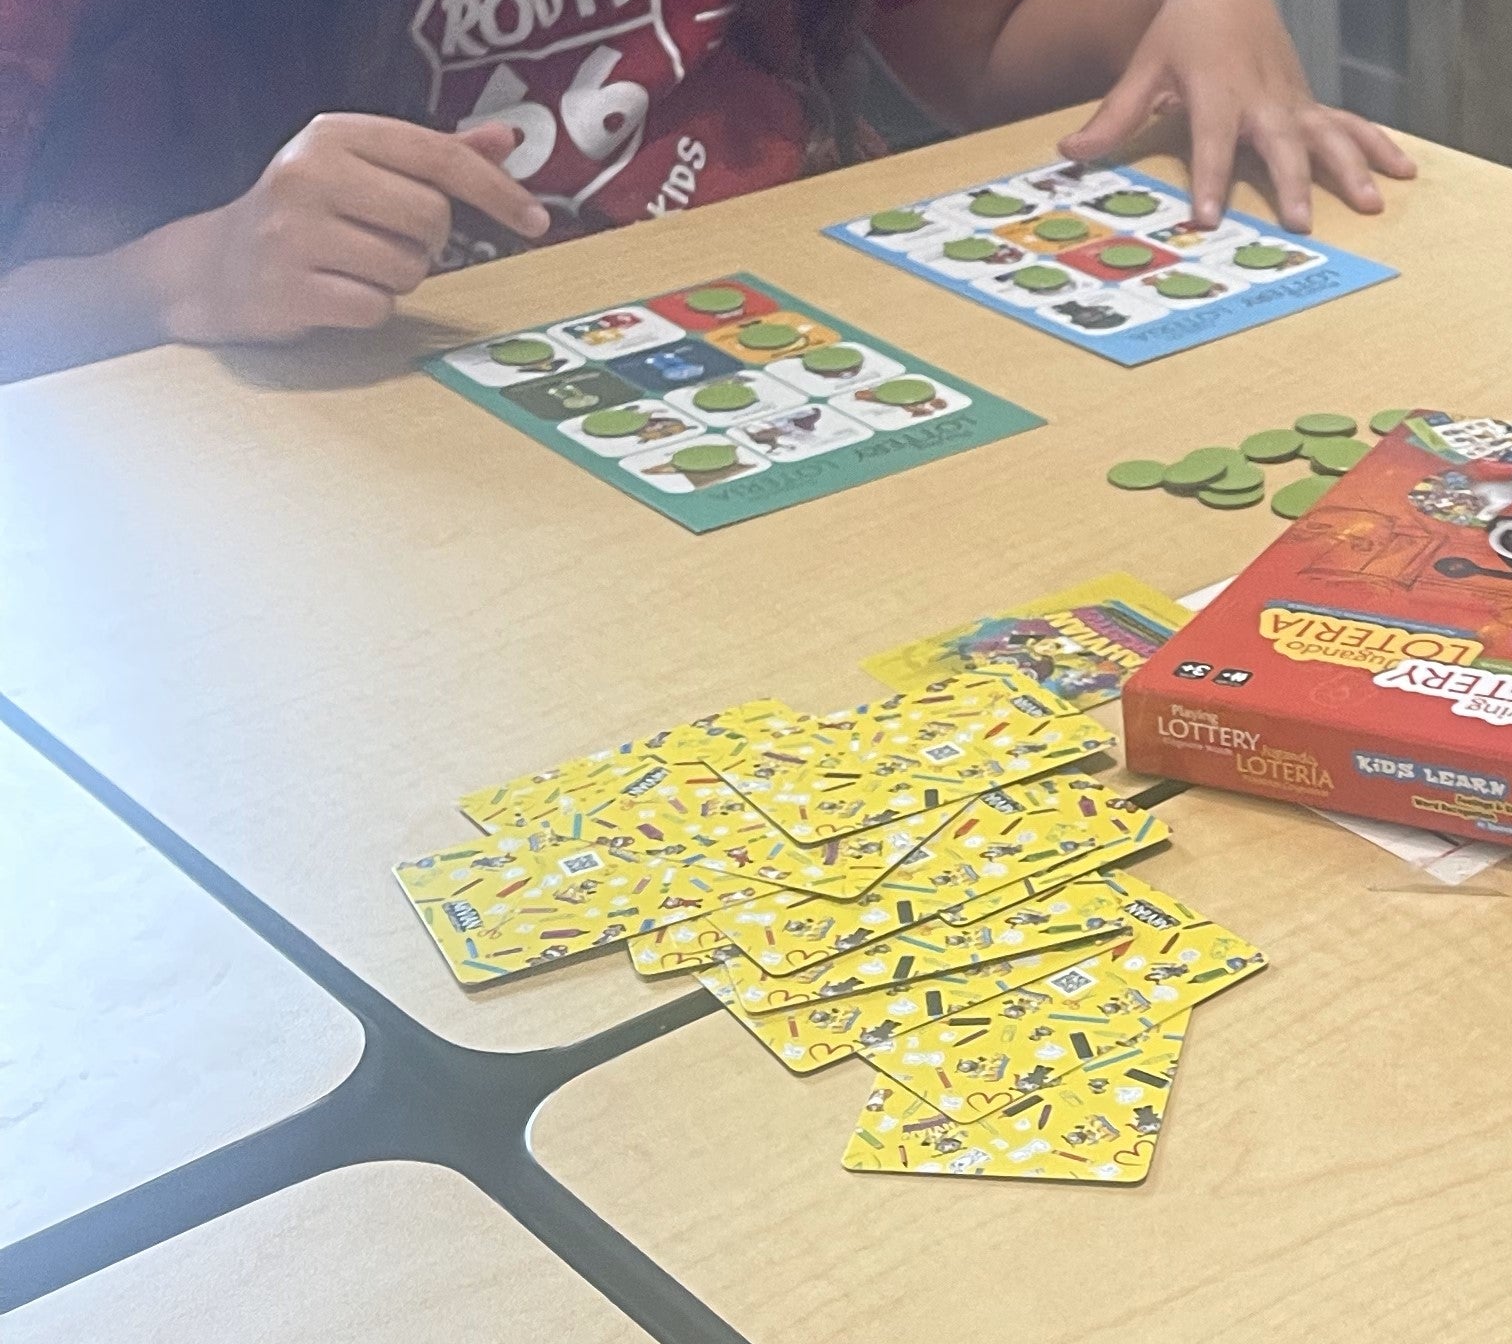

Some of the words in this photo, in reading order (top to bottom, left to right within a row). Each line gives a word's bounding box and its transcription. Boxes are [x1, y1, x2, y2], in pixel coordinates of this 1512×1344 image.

[456, 45, 650, 180] 66
[646, 136, 707, 218] KIDS
[1157, 715, 1261, 752] LOTTERY
[1423, 767, 1506, 797] LEARN
